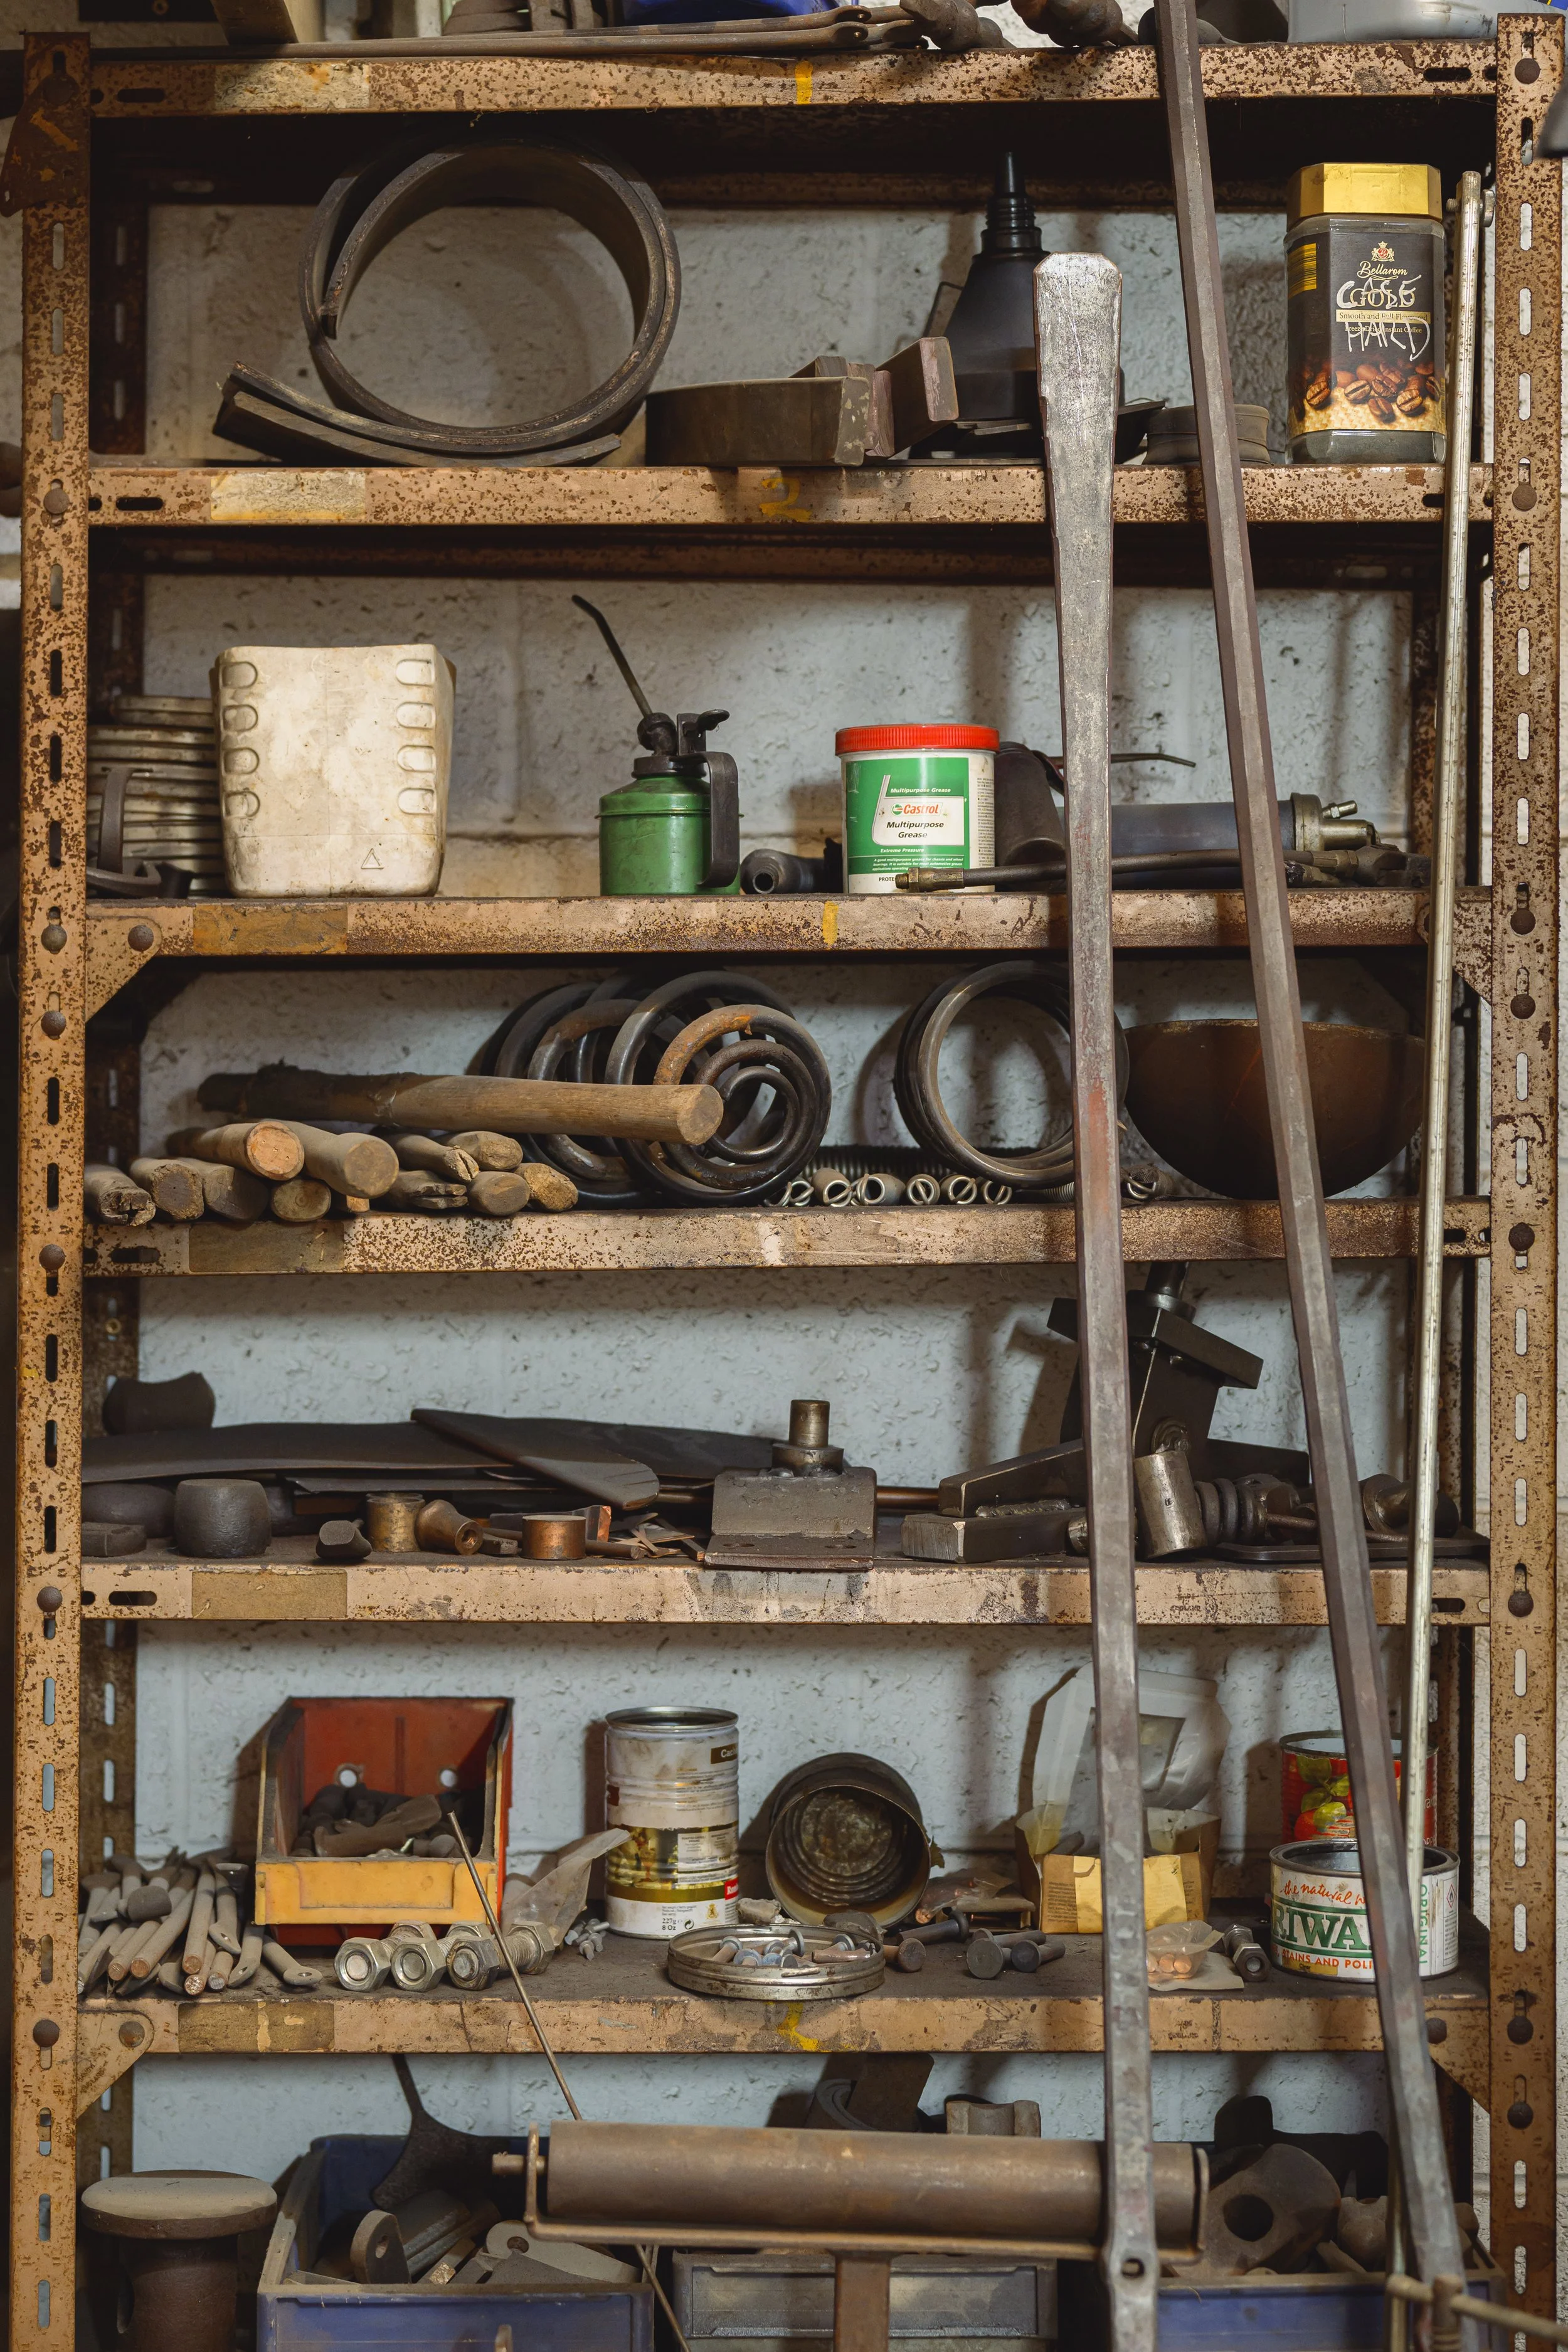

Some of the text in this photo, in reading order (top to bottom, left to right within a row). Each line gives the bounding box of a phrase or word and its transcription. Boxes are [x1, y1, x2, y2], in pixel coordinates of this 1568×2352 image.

[1357, 261, 1408, 280] Bellarom
[1337, 274, 1422, 310] CASE
[1345, 316, 1431, 362] HARD
[760, 477, 813, 522] 2
[903, 803, 939, 814] Castrol
[886, 821, 944, 830] Multipurpose
[1284, 1880, 1300, 1895] the
[1300, 1883, 1352, 1905] natural
[1273, 1901, 1371, 1951] RIWA
[1282, 1948, 1311, 1963] STAINS
[1315, 1957, 1340, 1968] AND
[1345, 1959, 1372, 1969] POLI
